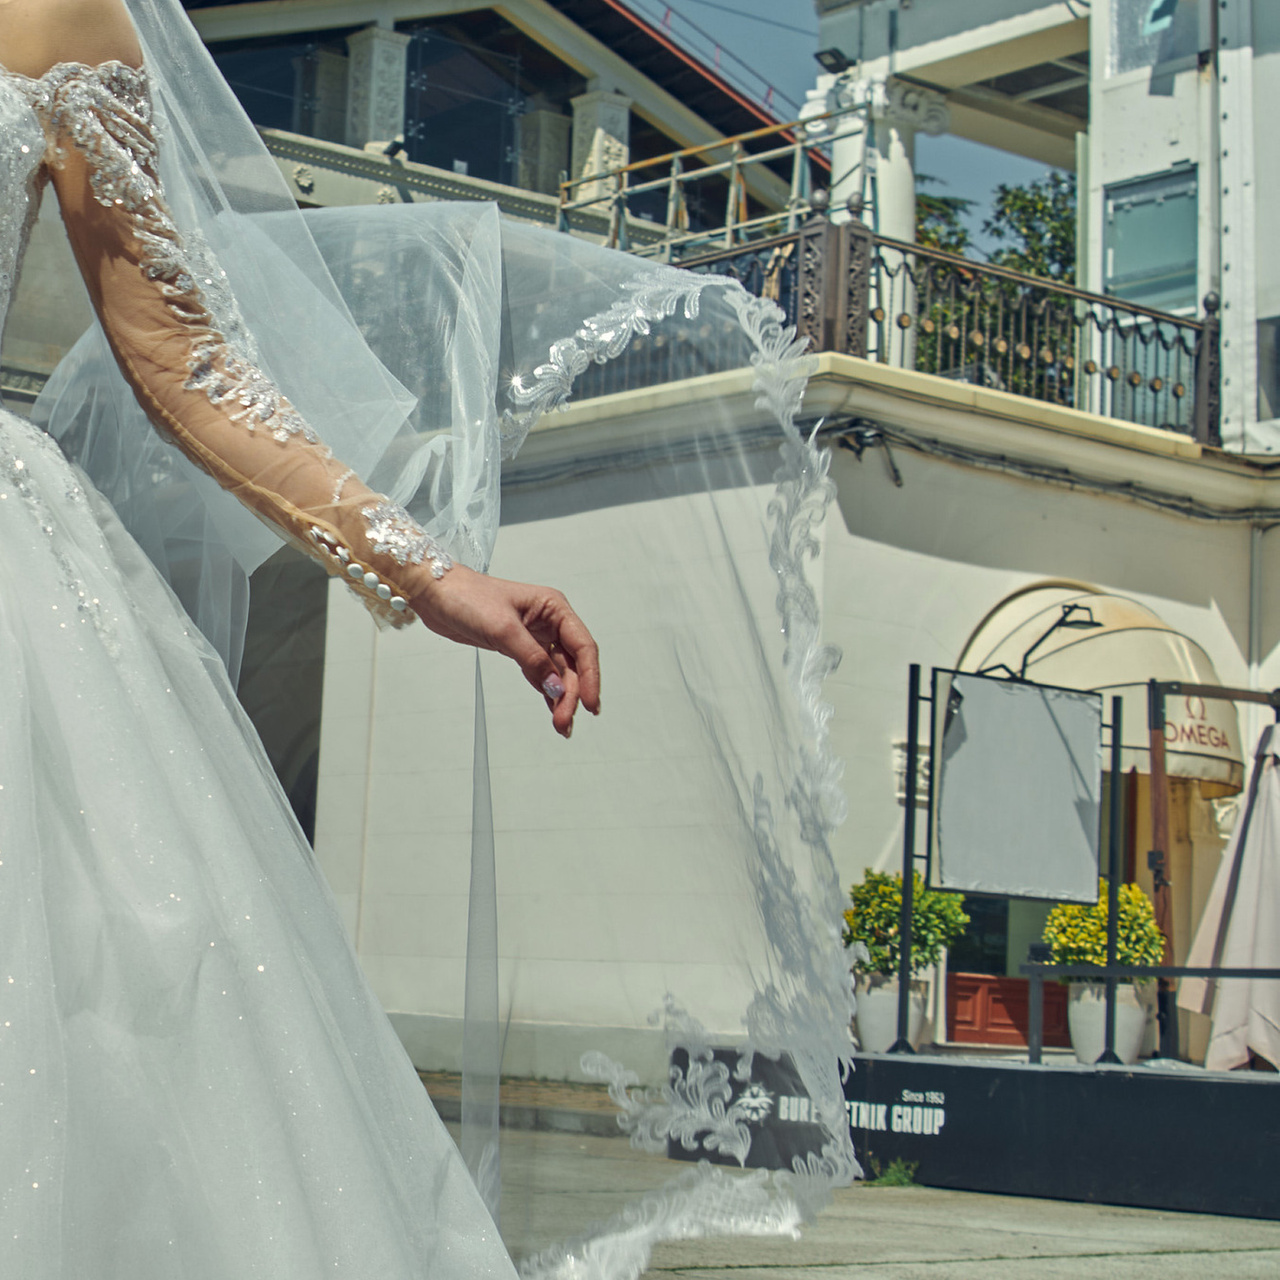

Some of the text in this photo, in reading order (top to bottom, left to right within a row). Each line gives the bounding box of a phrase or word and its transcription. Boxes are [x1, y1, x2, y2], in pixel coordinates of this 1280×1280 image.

[1164, 721, 1231, 751] OMEGA
[778, 1095, 946, 1135] BURETNIK GROUP
